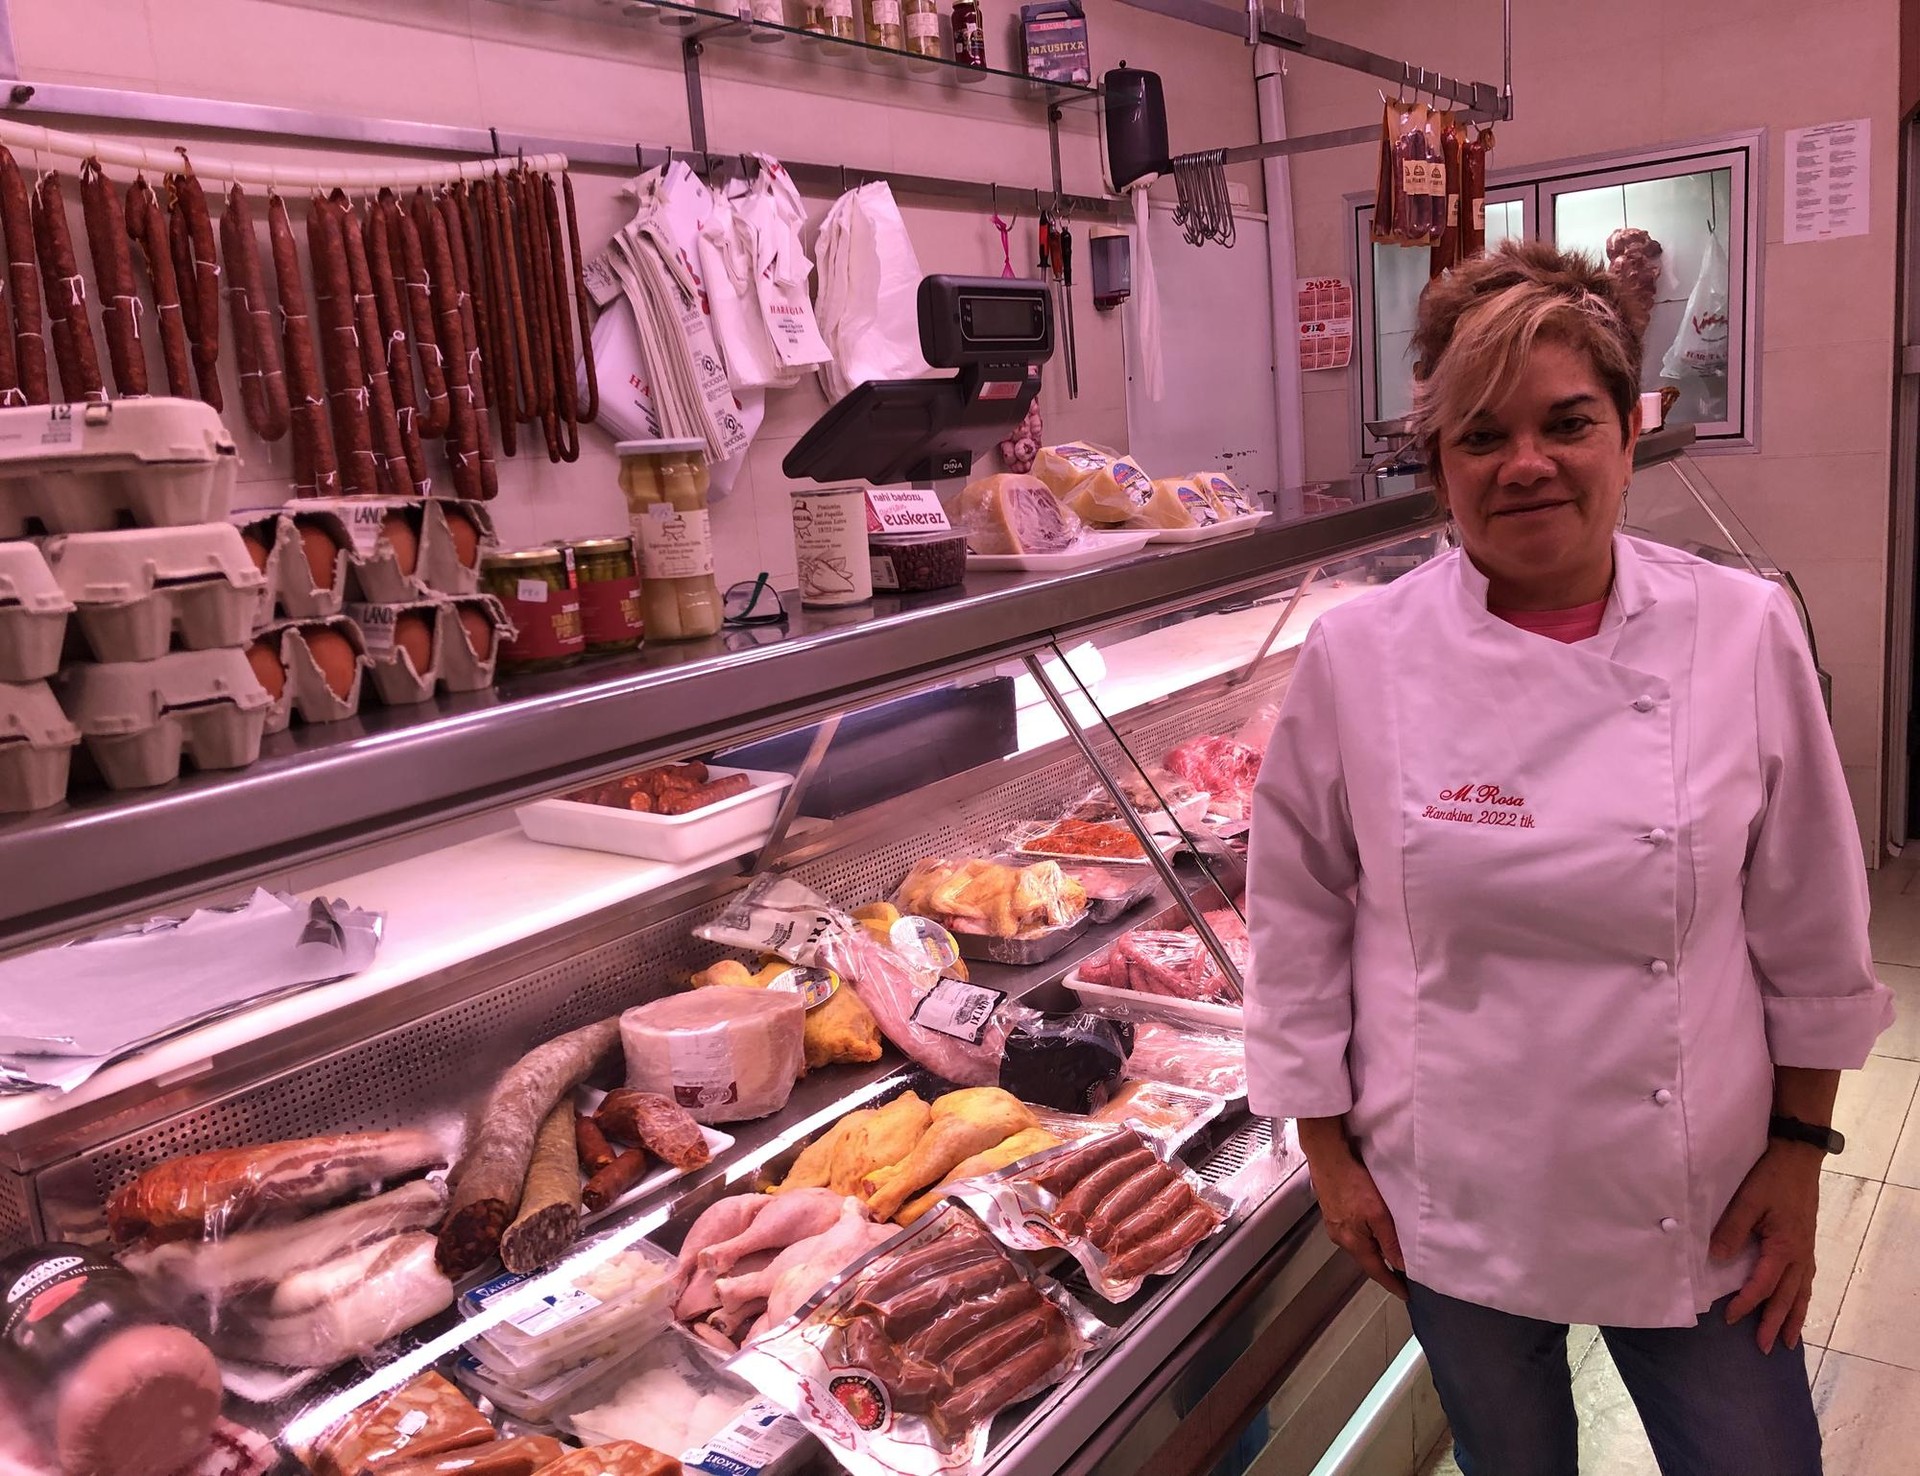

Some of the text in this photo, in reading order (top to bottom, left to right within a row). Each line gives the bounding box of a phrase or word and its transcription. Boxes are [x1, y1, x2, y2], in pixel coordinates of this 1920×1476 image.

[1030, 41, 1085, 55] MAUSITXA
[1306, 279, 1342, 291] 2022
[50, 404, 72, 420] 12
[943, 462, 963, 471] DINA
[873, 492, 890, 502] nahi
[883, 510, 945, 526] euskeraz
[1439, 784, 1525, 807] M. Rosa
[1421, 805, 1536, 829] Harakina 2022 tik
